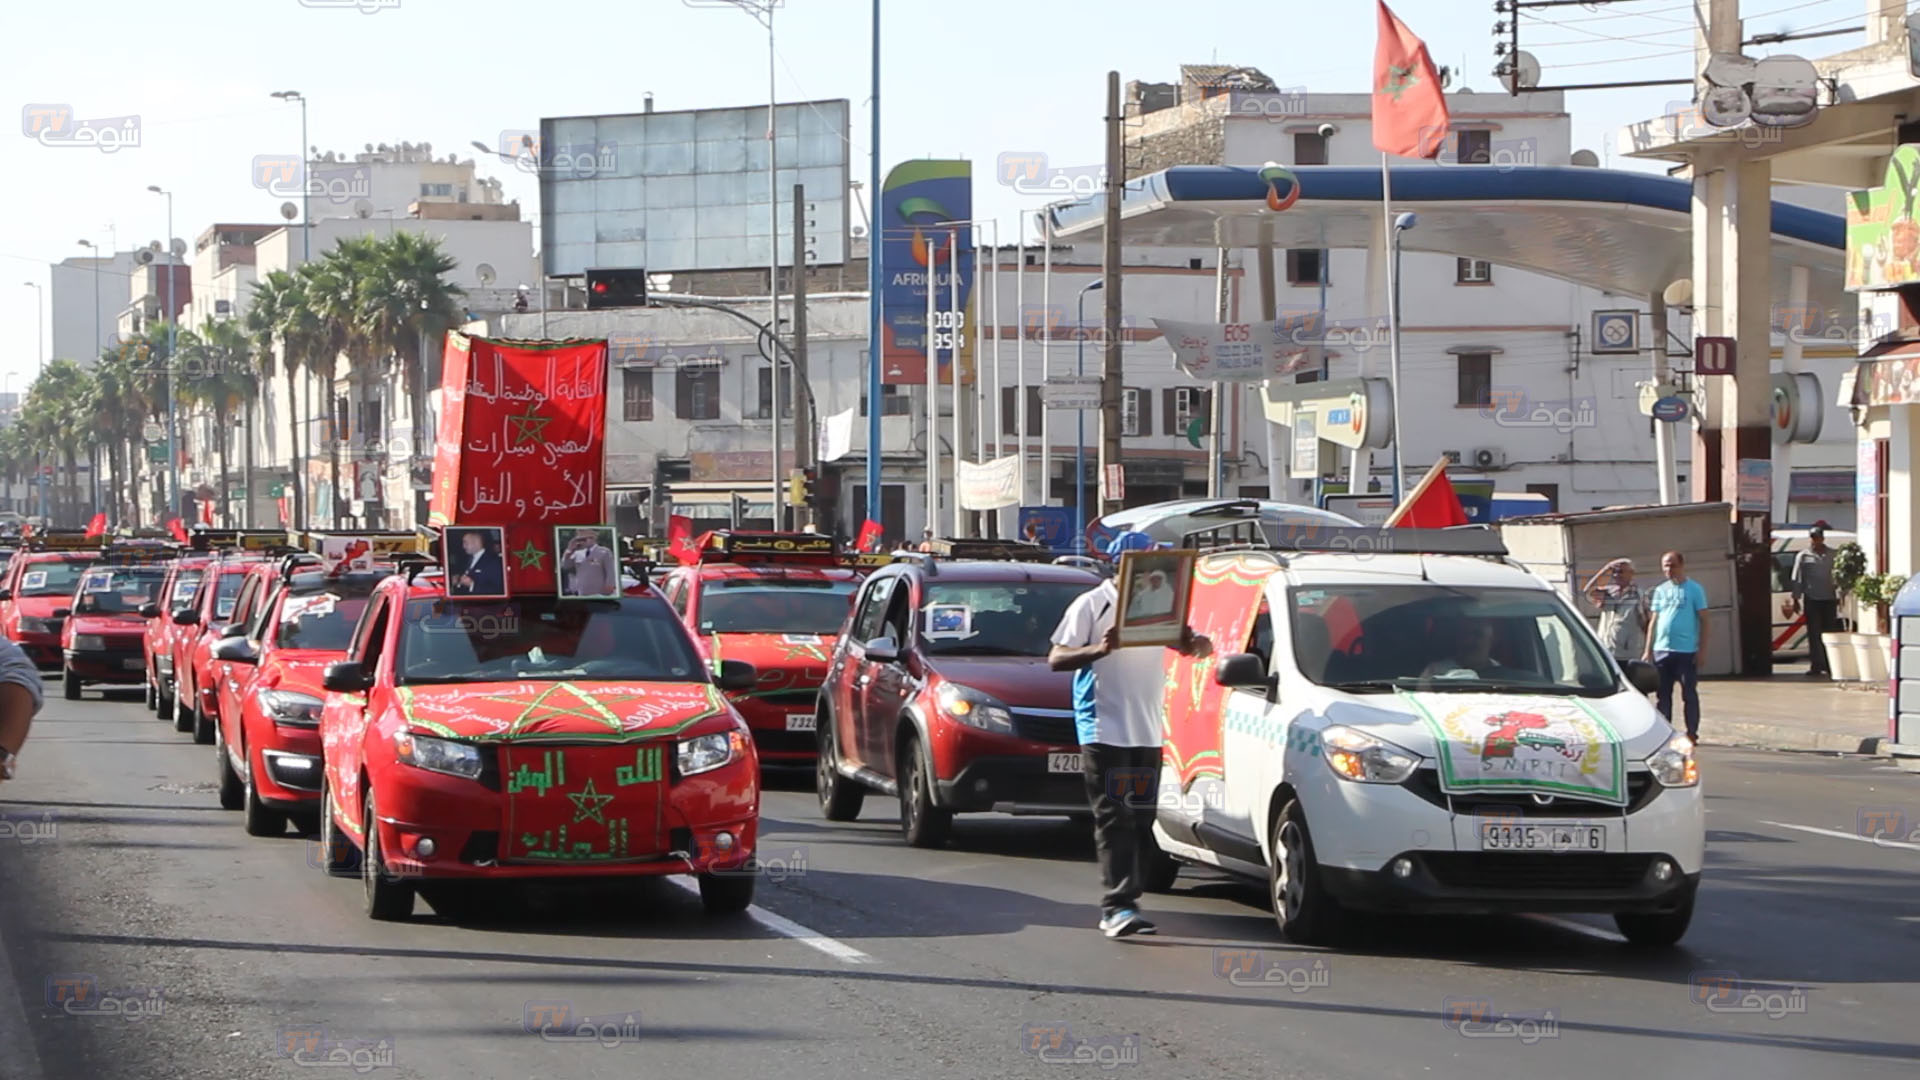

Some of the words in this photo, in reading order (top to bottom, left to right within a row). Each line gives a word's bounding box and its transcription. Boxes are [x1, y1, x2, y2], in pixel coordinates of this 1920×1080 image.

[892, 273, 964, 285] AFRIUA
[503, 356, 556, 411] الوطنية
[556, 348, 606, 405] النقابة
[468, 415, 534, 467] سيارات
[459, 472, 511, 513] النقل
[533, 469, 592, 520] الأجرة
[616, 747, 662, 786] الله
[1489, 827, 1535, 848] 9335
[1589, 828, 1599, 848] 6
